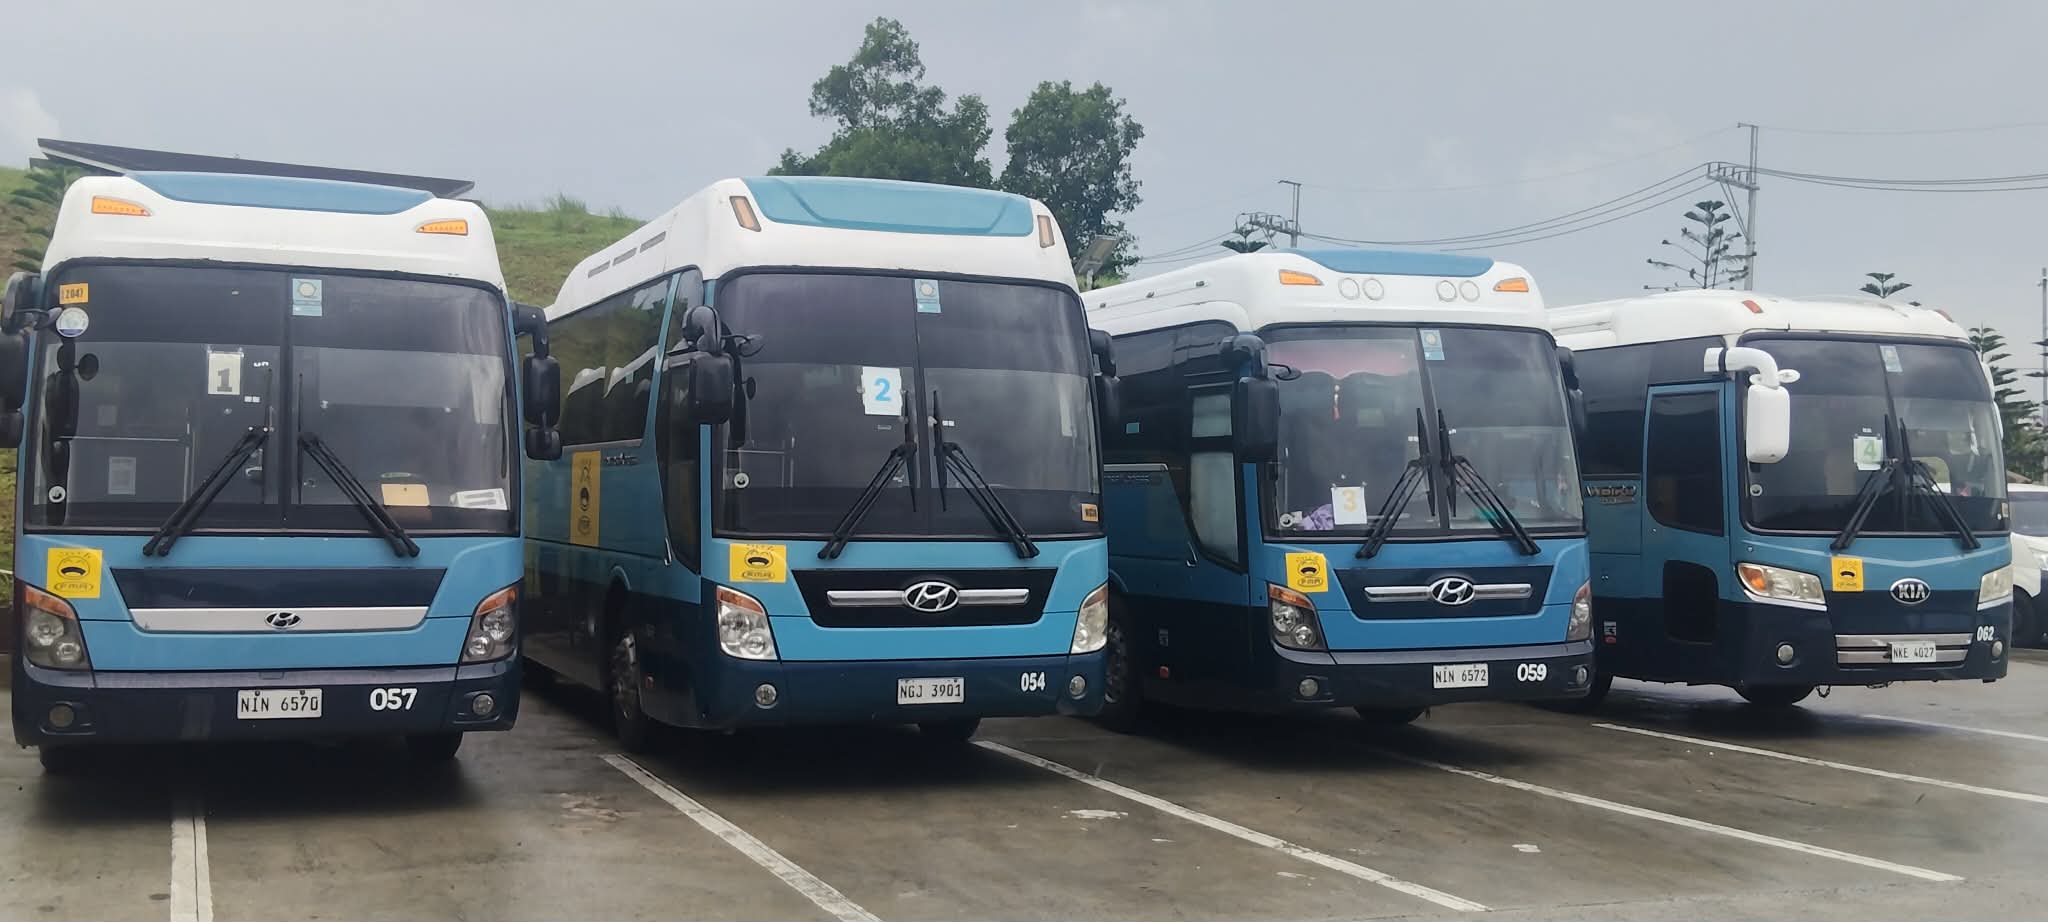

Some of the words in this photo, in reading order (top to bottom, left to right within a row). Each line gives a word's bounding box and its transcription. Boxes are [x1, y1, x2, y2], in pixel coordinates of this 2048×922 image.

[217, 368, 233, 393] 1
[874, 378, 891, 401] 2
[1864, 440, 1877, 458] 4
[1343, 489, 1357, 512] 3
[1898, 583, 1926, 599] KIA
[1977, 626, 1995, 641] 062
[1893, 647, 1908, 659] NKE
[1914, 646, 1934, 658] 4027
[1020, 672, 1046, 691] 054
[1435, 670, 1455, 683] NIN
[1461, 669, 1486, 682] 6572
[1517, 663, 1547, 682] 059
[369, 688, 418, 711] 057
[900, 685, 923, 698] NGJ
[931, 684, 961, 698] 3901
[240, 697, 270, 712] NIN
[280, 696, 319, 712] 6570
